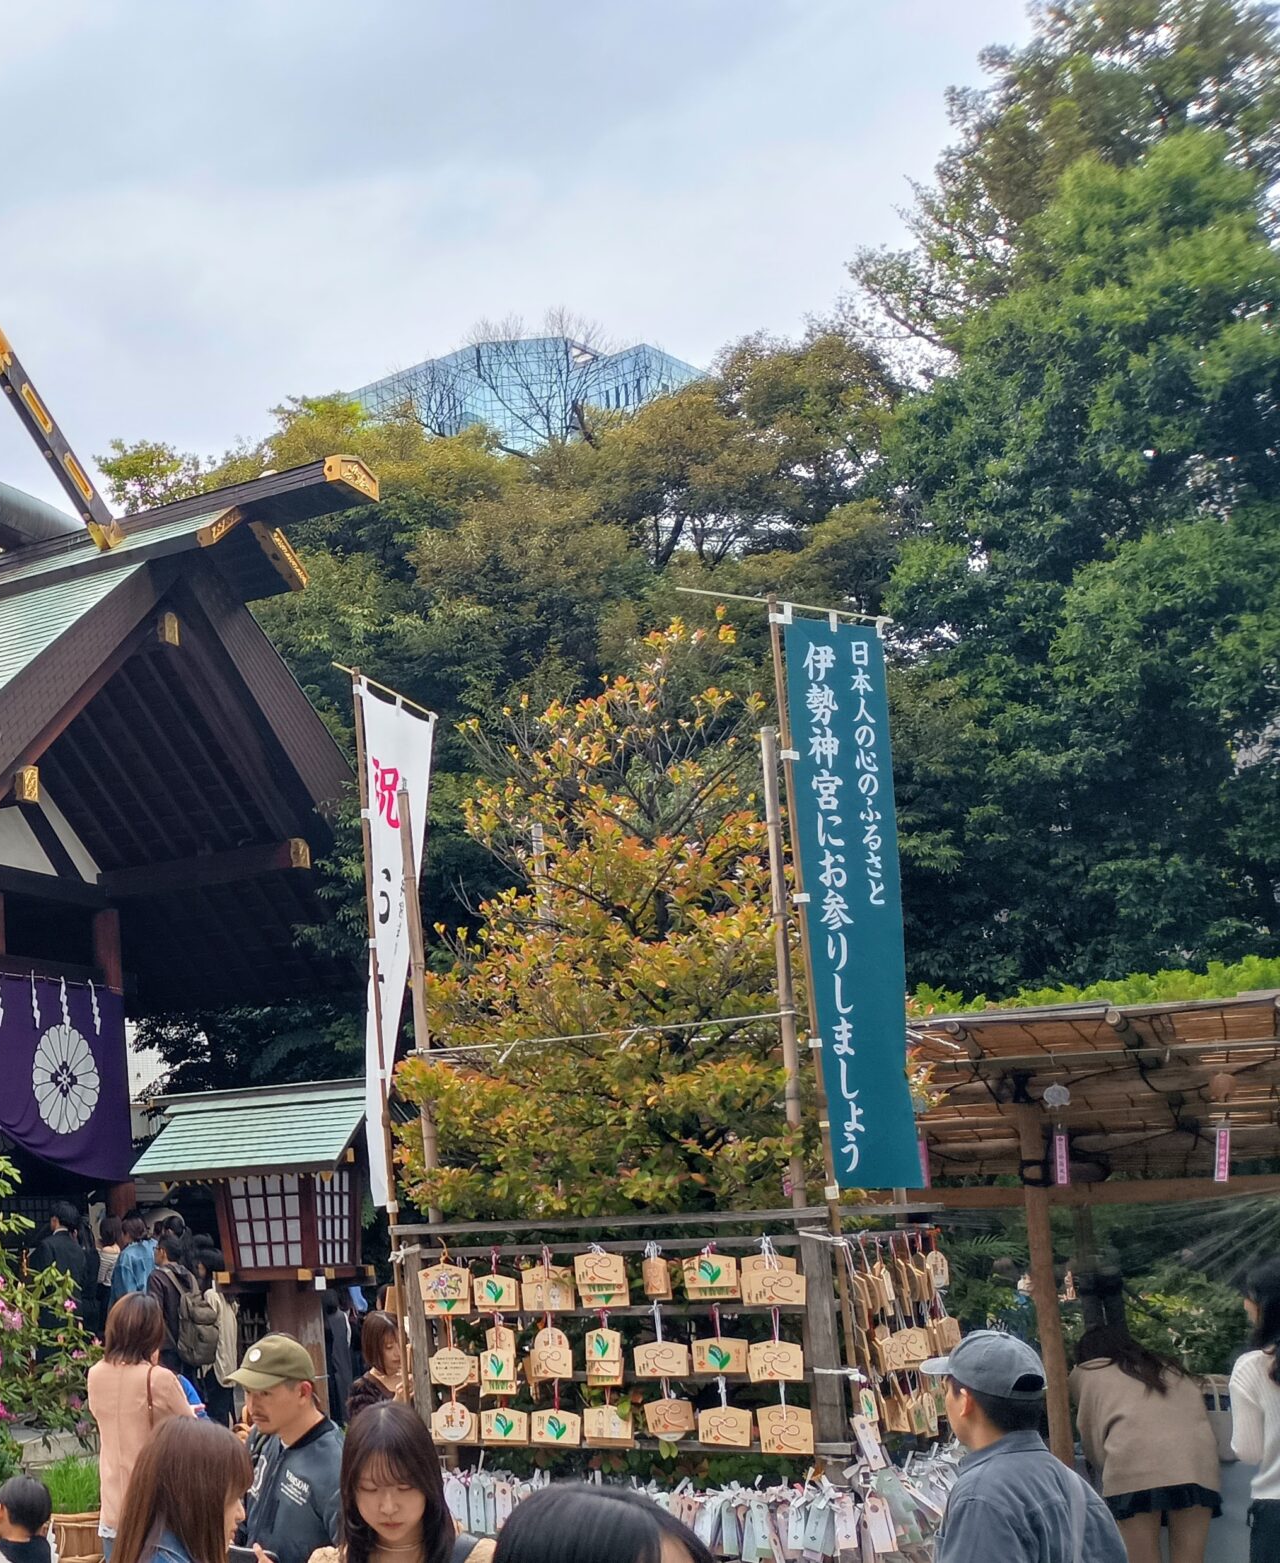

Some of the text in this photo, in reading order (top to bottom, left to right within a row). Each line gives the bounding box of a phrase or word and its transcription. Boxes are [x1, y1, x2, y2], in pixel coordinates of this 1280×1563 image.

[803, 641, 865, 1173] 伊勢神宮にお参りしましょう
[850, 641, 885, 905] 日本人の心のふるさと
